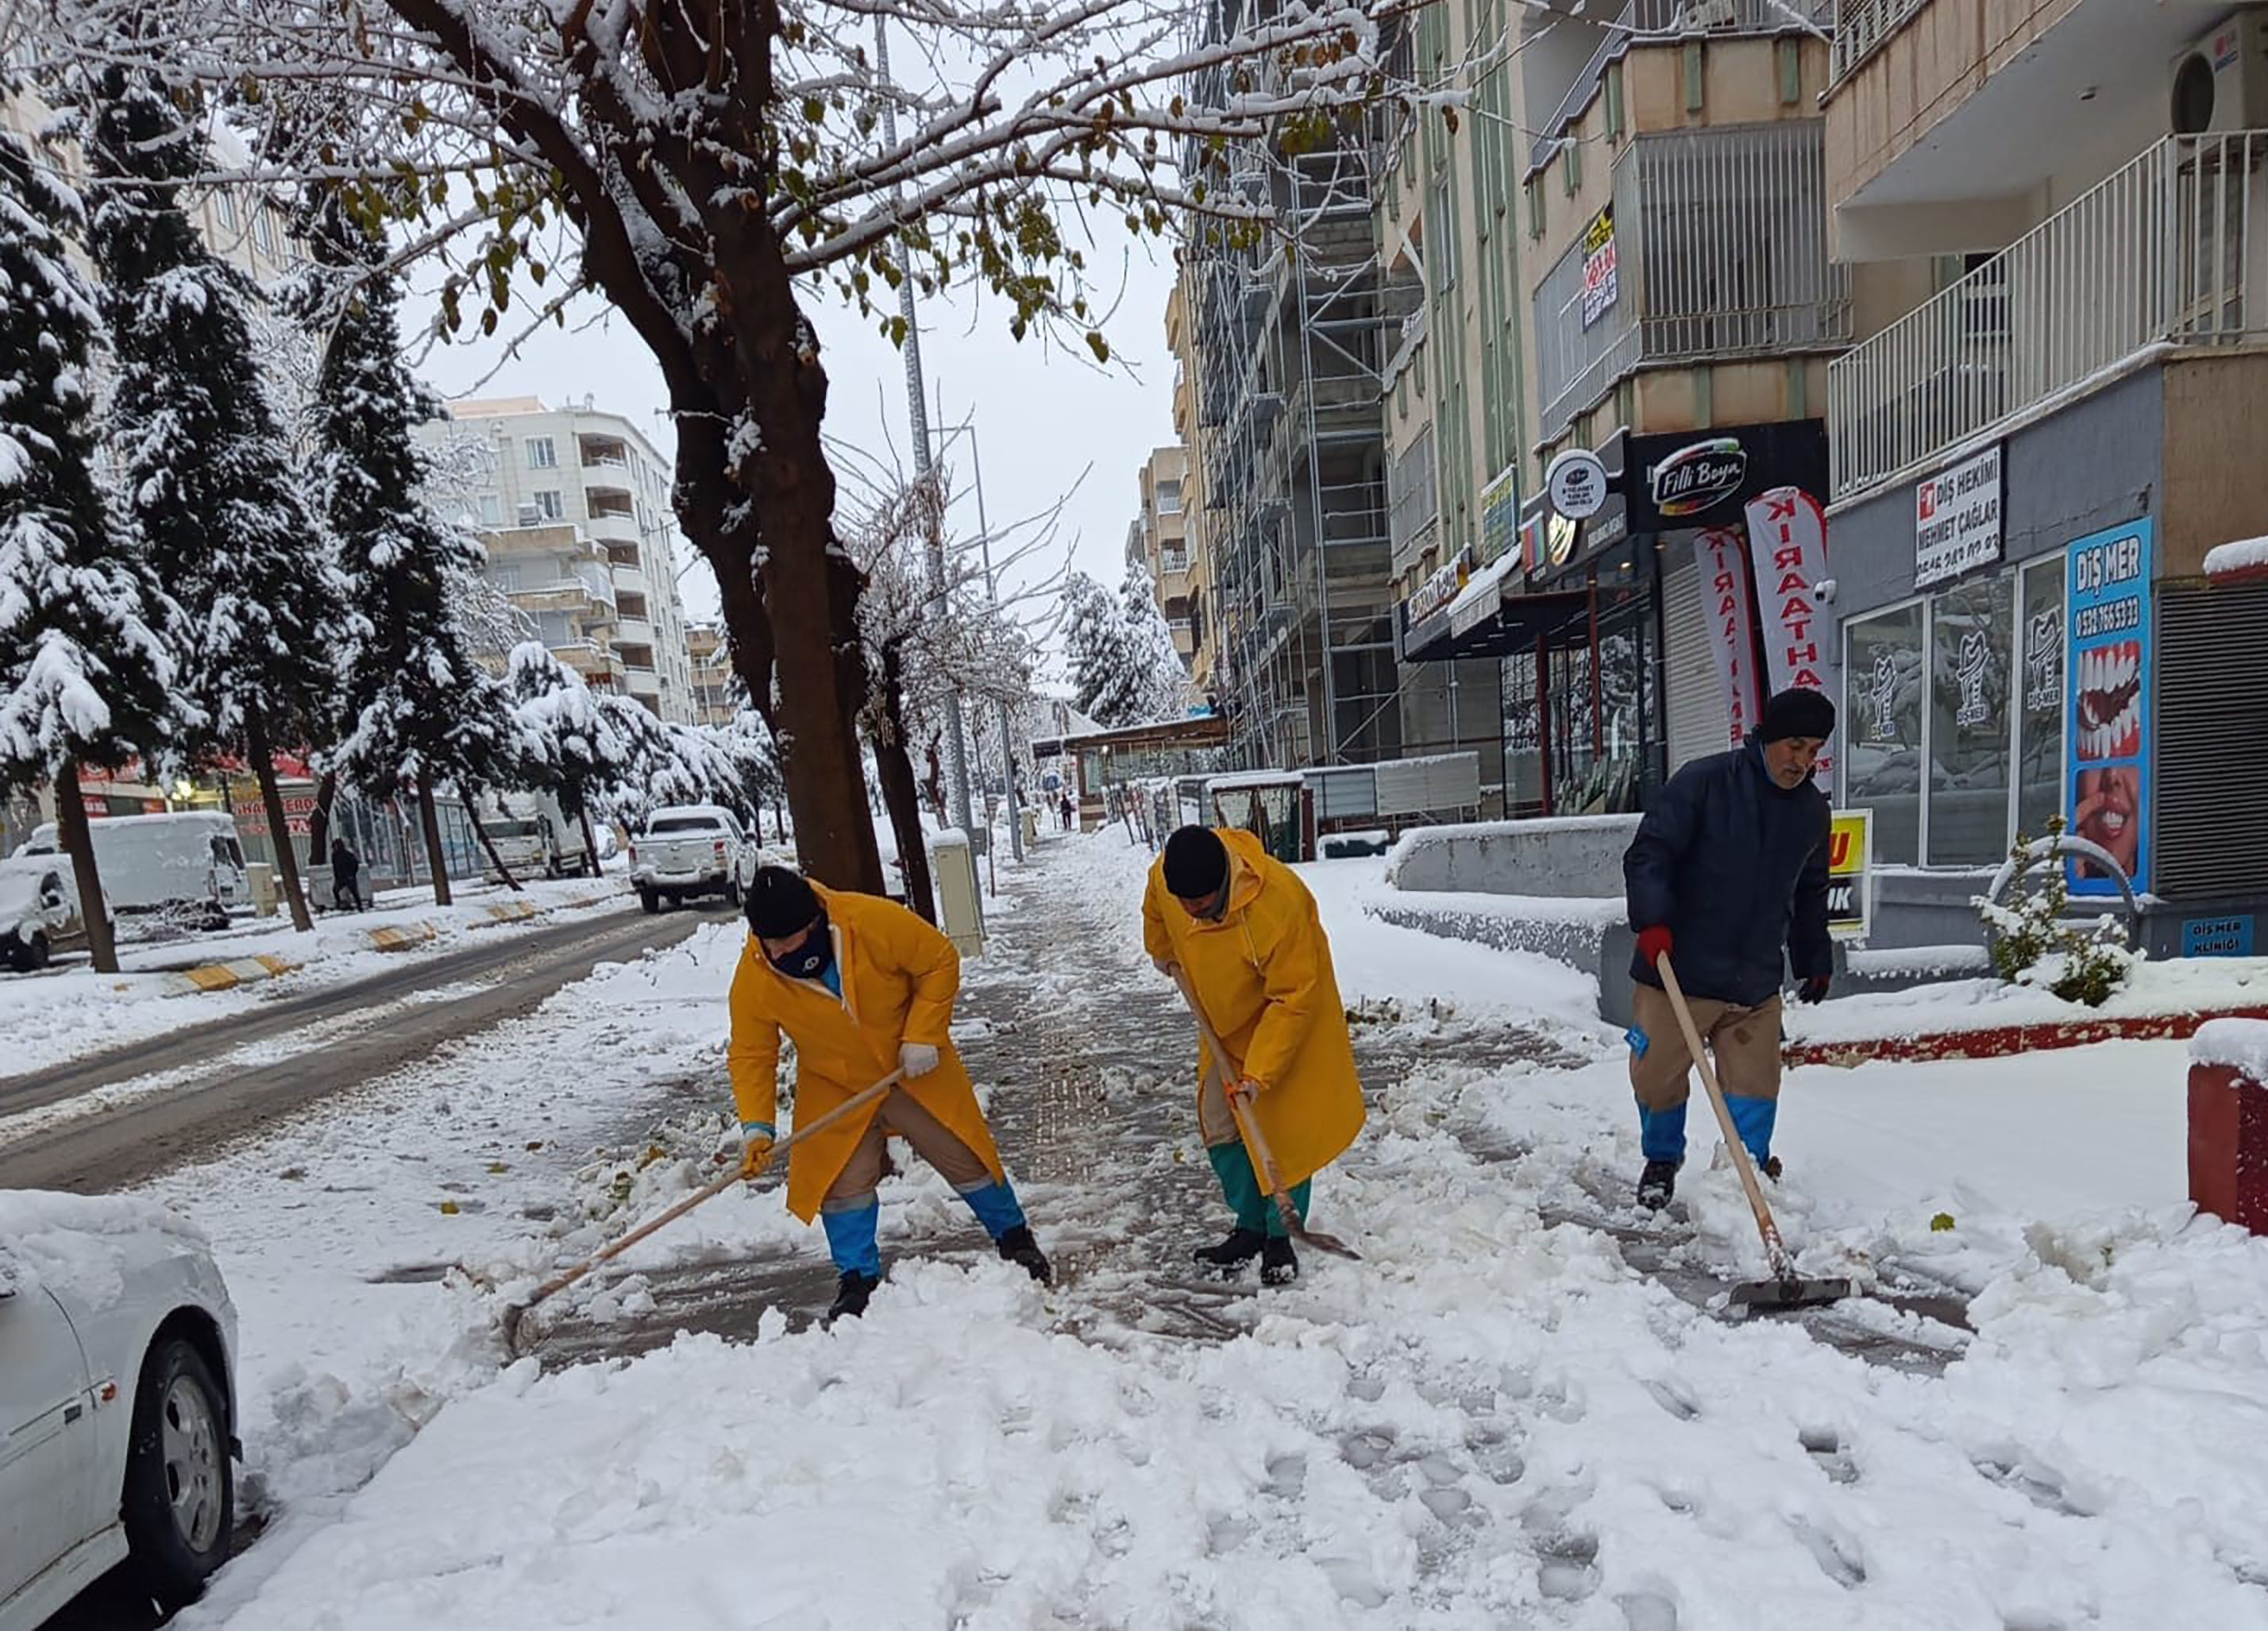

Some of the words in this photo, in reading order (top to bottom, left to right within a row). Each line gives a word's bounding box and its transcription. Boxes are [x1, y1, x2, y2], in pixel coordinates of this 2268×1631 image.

[1663, 465, 1694, 496] Filli
[1696, 462, 1742, 487] Boya
[1936, 473, 1955, 507] DİŞ
[1957, 451, 1999, 496] HEKİMİ
[1918, 516, 1957, 551] MEHMET
[1958, 499, 1998, 542] ÇAĞLAR
[2076, 546, 2102, 597] DİŞ
[2104, 535, 2141, 585] MER
